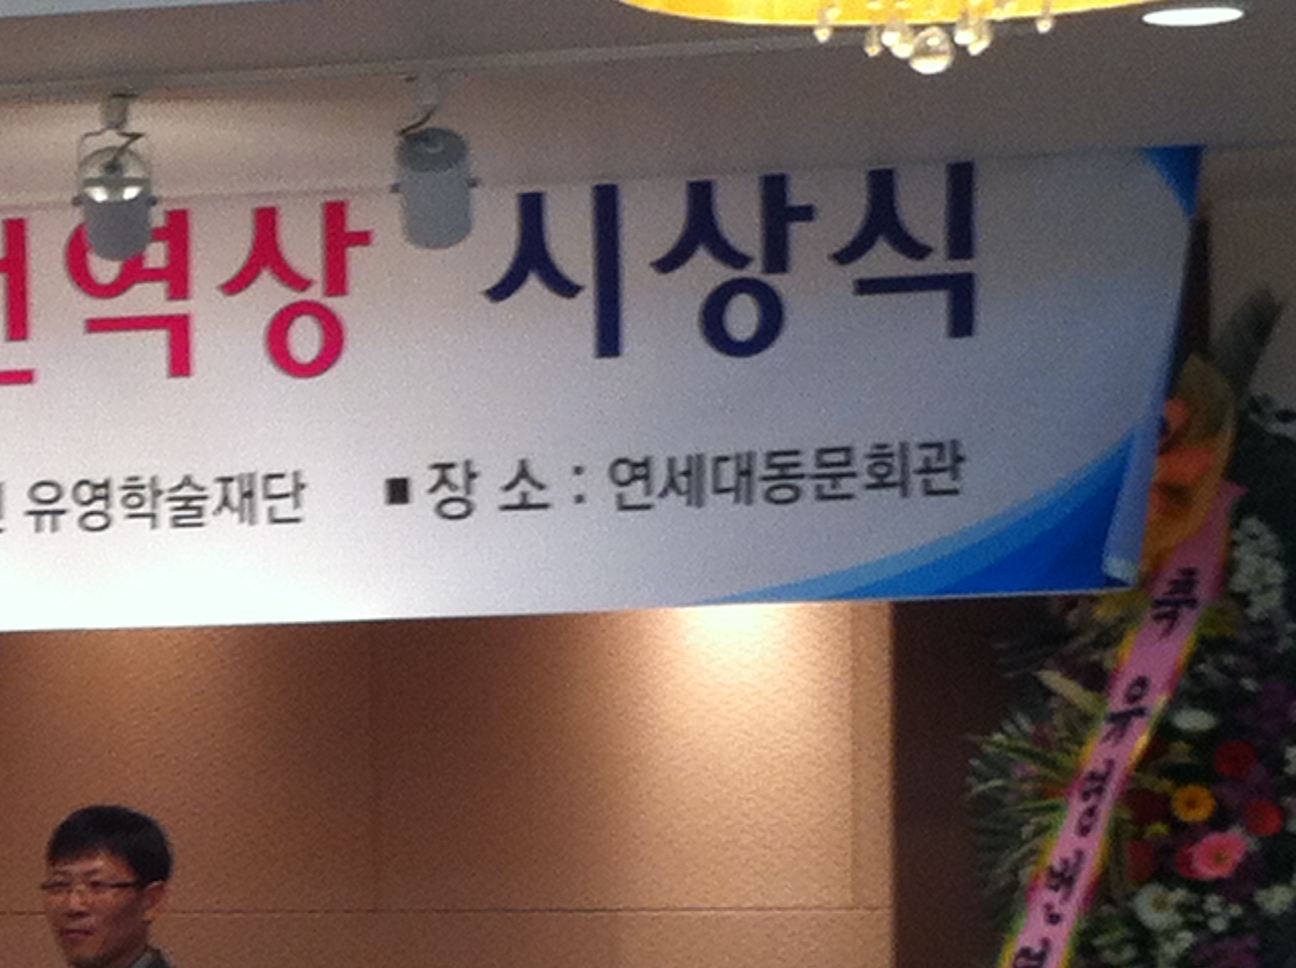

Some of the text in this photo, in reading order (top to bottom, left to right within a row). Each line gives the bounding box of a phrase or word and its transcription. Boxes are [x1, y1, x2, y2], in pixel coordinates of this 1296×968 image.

[481, 160, 978, 359] 시상식
[24, 470, 307, 533] 유영학술재단
[427, 459, 480, 521] 장
[608, 439, 967, 511] 연세대동문회관
